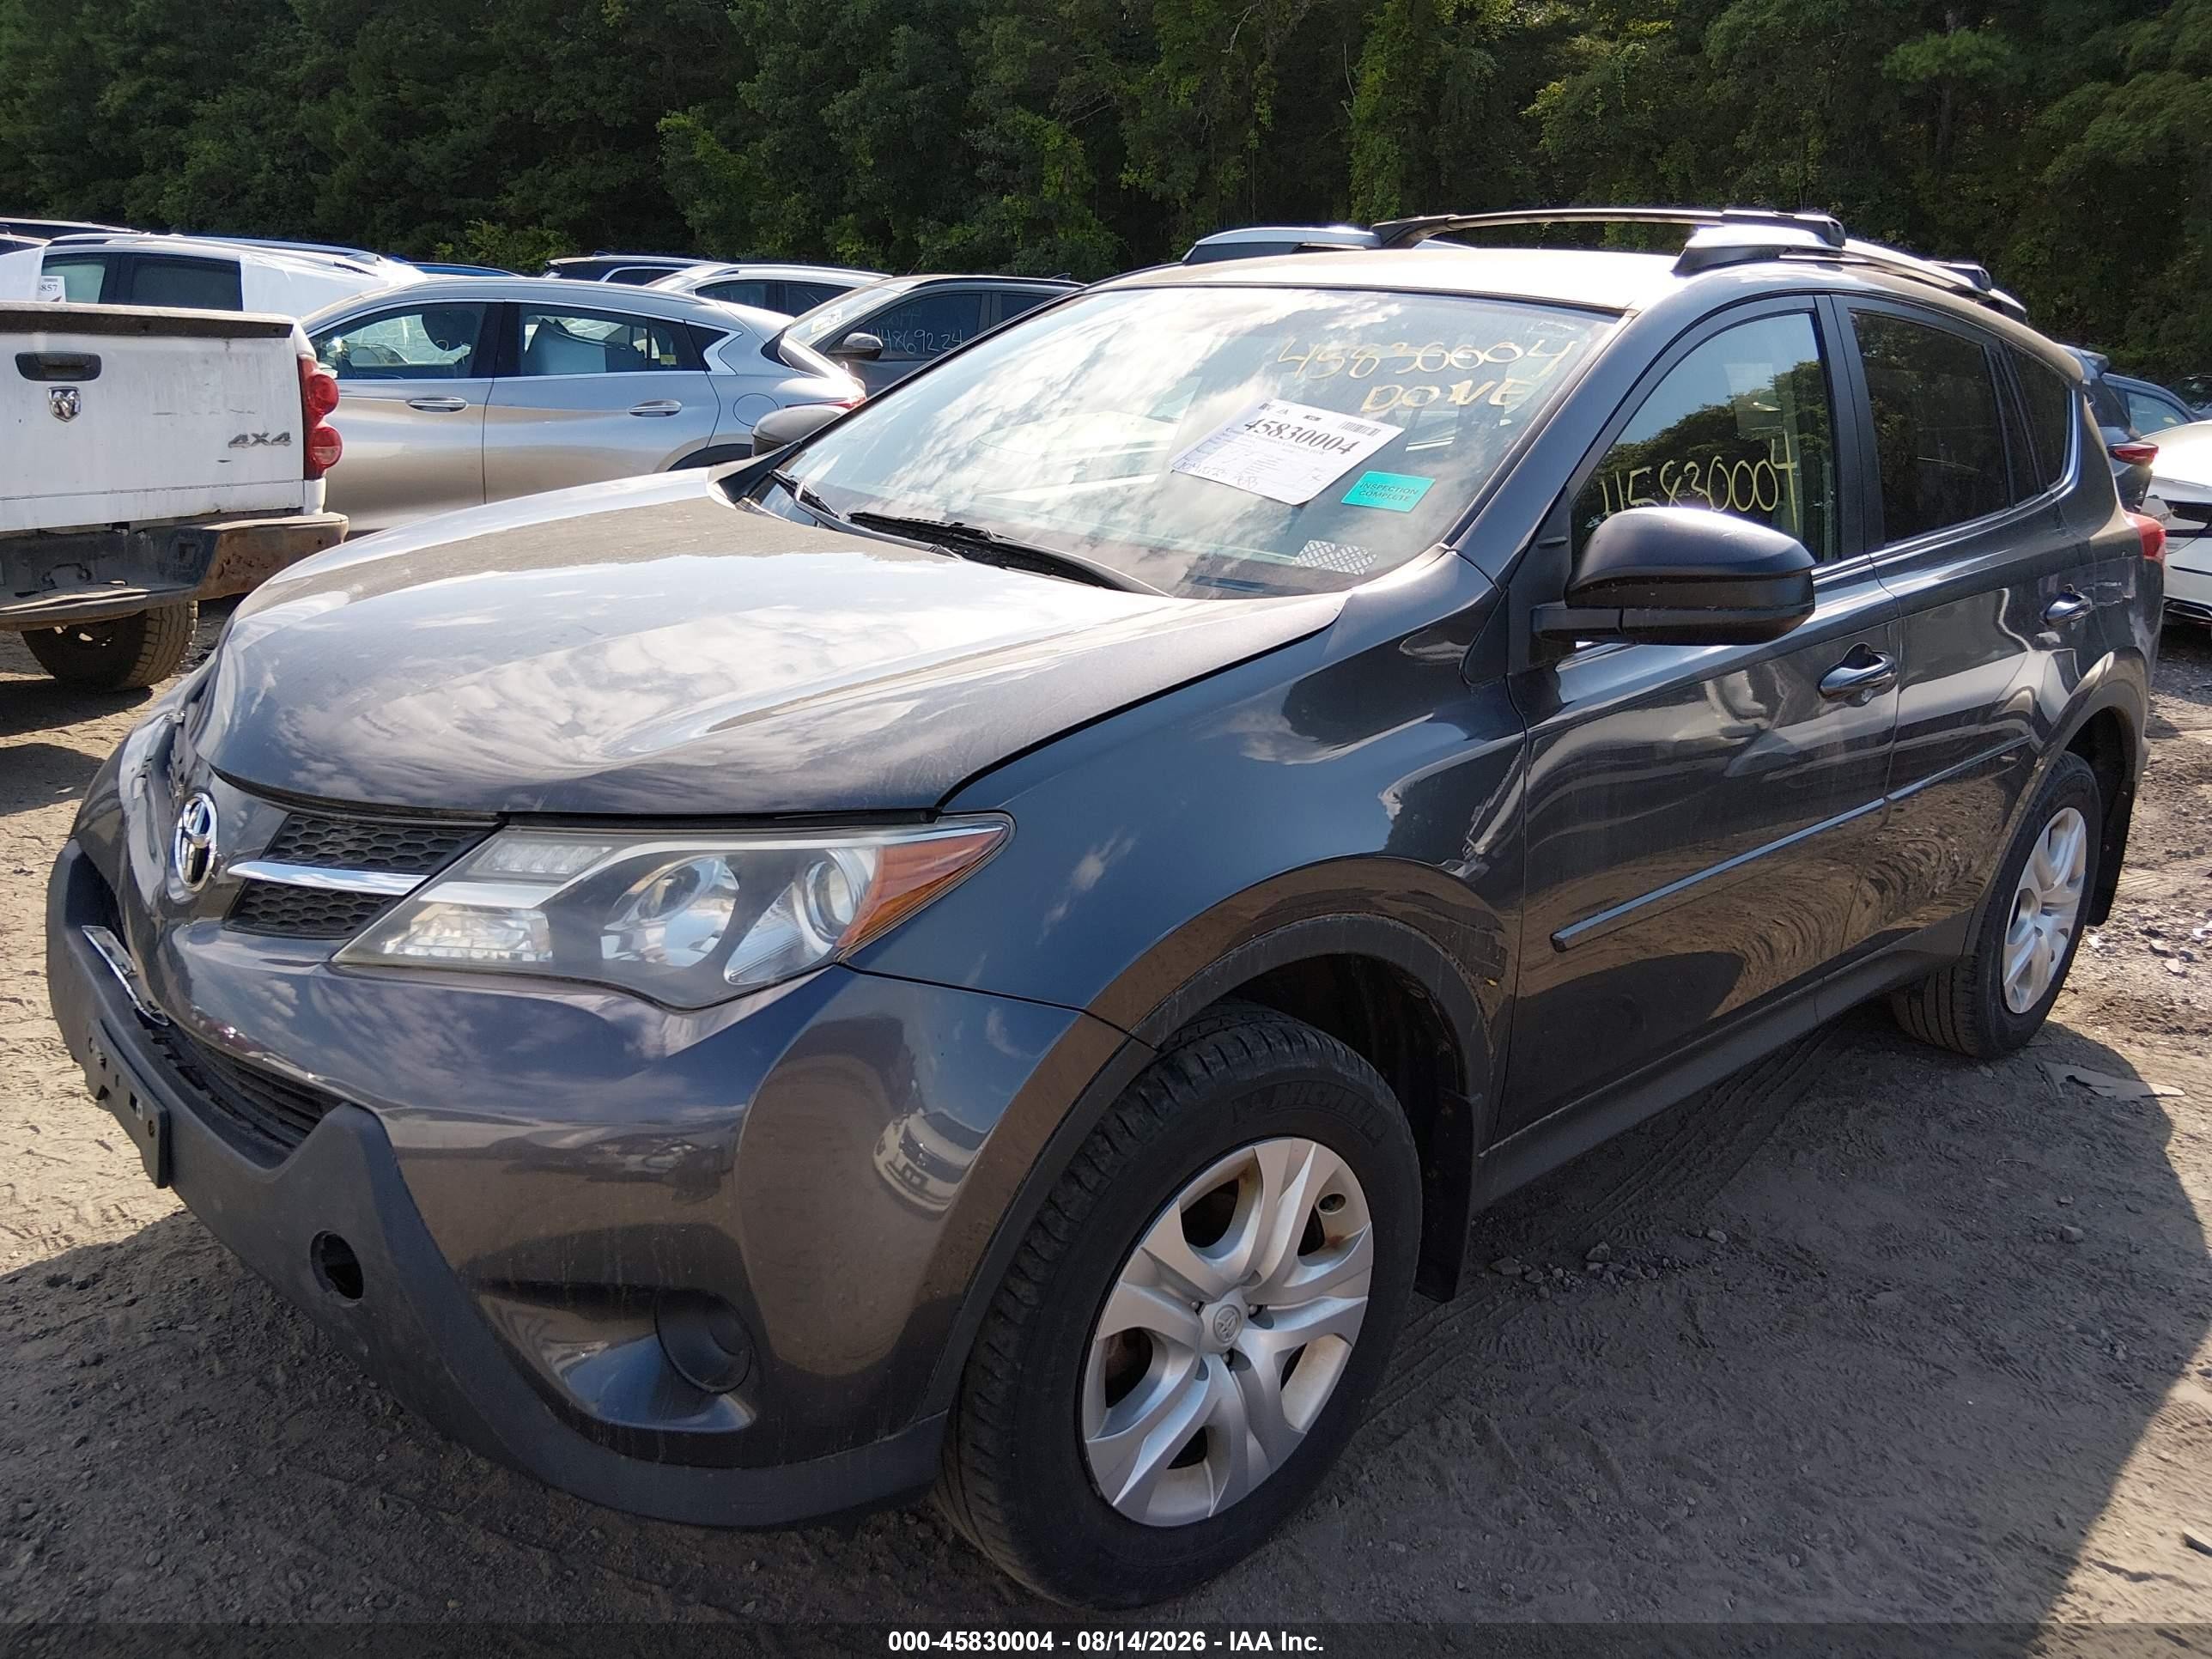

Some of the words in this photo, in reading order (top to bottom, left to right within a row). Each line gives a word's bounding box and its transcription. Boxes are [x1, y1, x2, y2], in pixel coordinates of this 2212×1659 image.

[1244, 417, 1362, 456] 45830004
[1359, 481, 1419, 495] INSPECTION
[1358, 489, 1411, 502] COMPLETE
